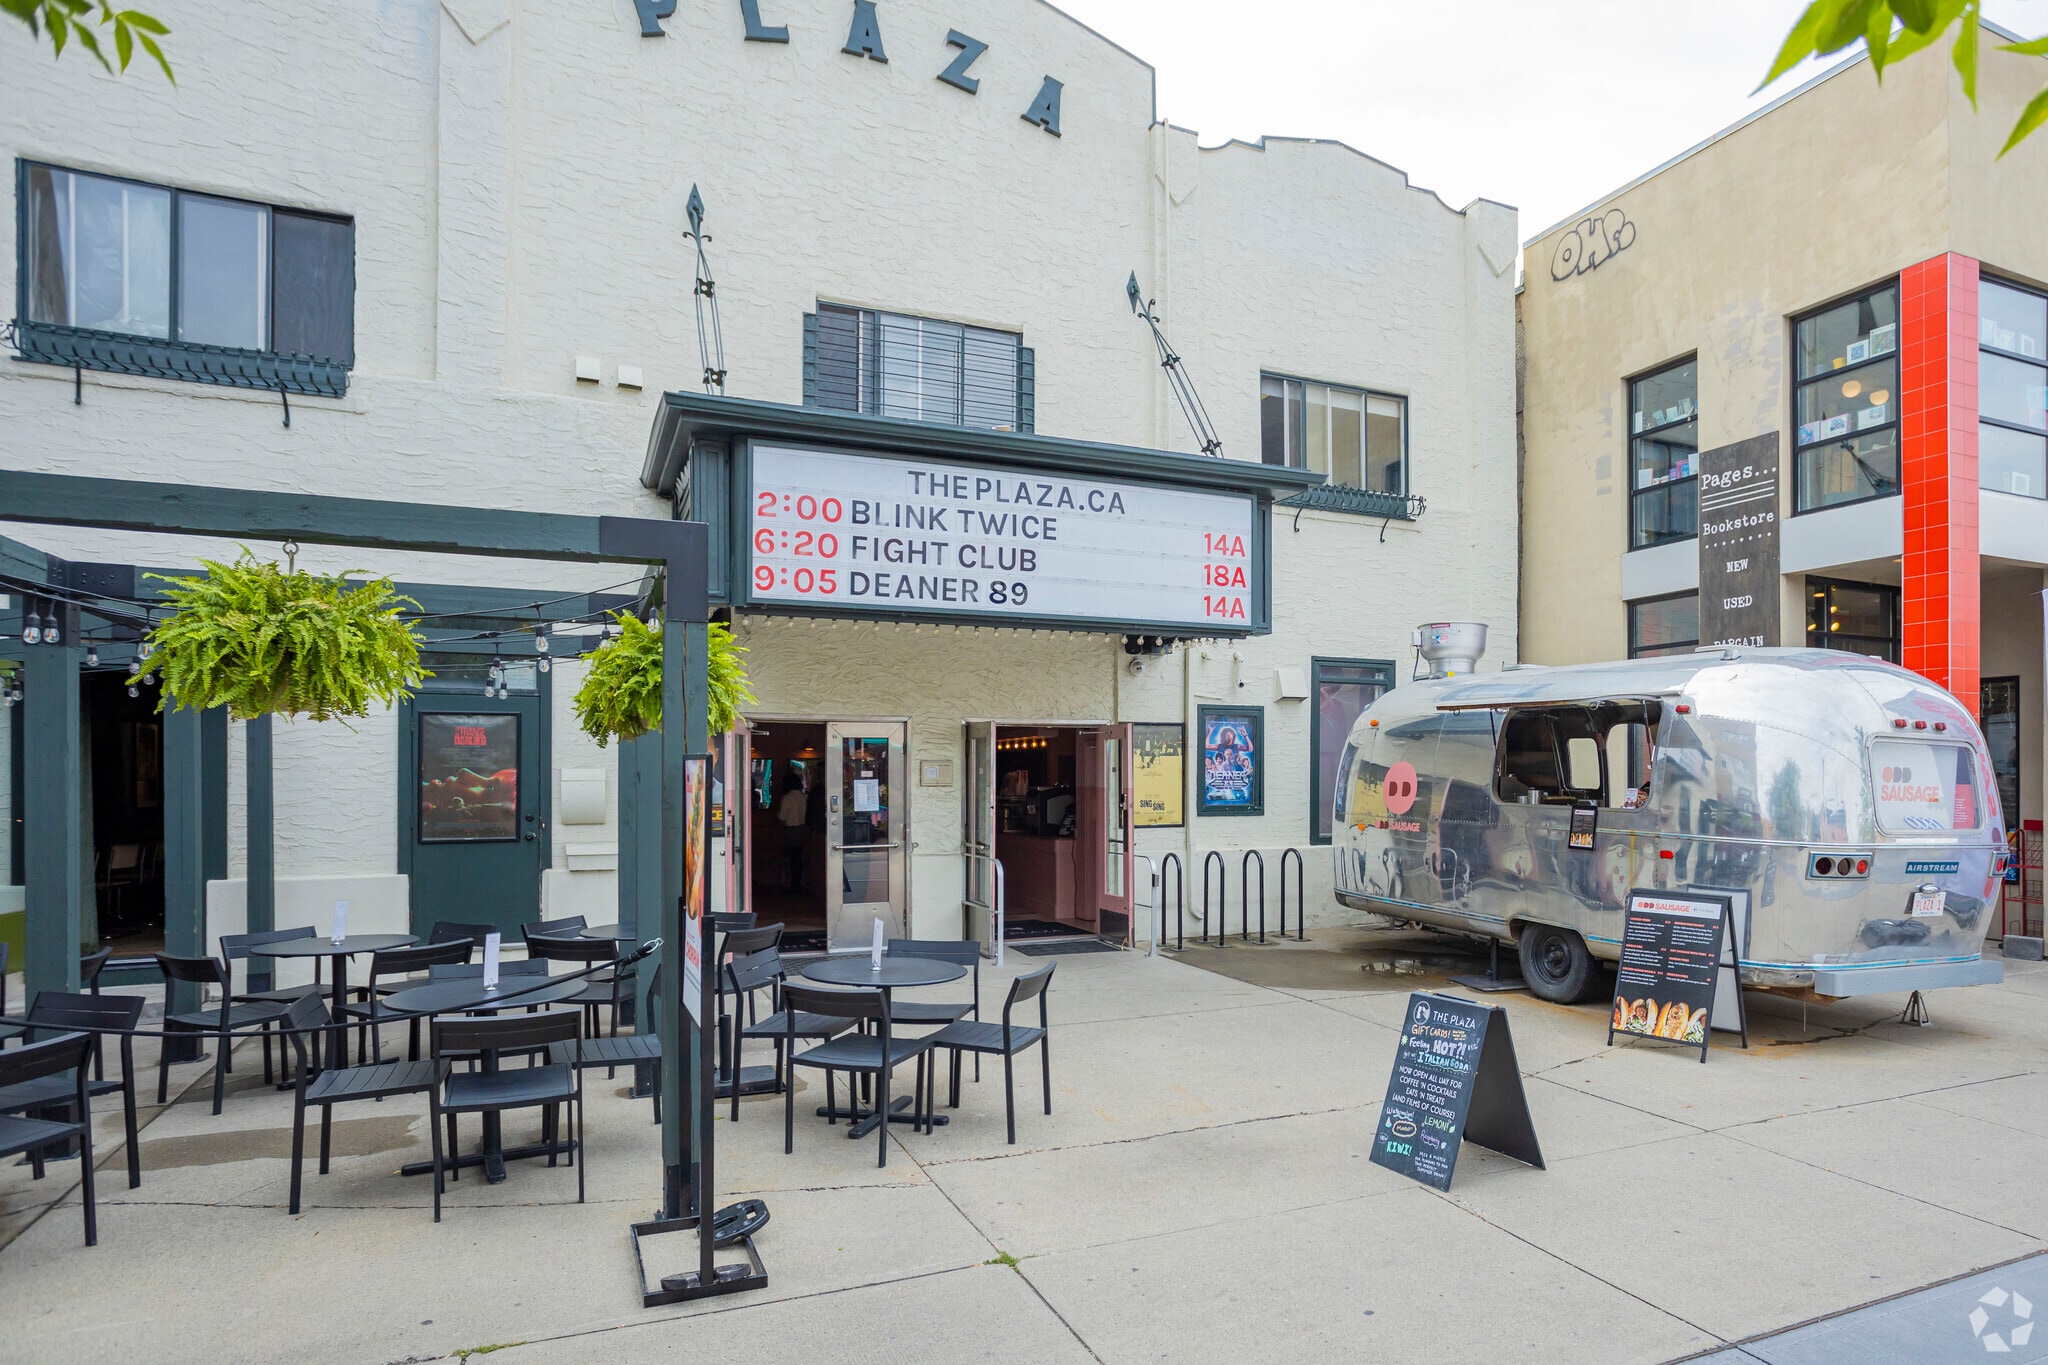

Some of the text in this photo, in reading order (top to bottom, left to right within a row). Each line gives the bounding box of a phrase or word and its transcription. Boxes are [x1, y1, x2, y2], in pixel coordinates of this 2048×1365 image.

[634, 0, 1064, 138] PLAZA
[1701, 465, 1777, 490] Pages...
[757, 491, 1058, 541] 2:00 BLINK TWICE
[1703, 512, 1774, 536] Bookstore
[755, 528, 1037, 572] 6:20 FIGHT CLUB
[1204, 533, 1246, 558] 14A
[1726, 559, 1749, 573] NEW
[1204, 564, 1246, 588] 18A
[755, 567, 1028, 606] 9:05 DEANER 89
[1204, 595, 1245, 619] 14A
[1724, 595, 1753, 609] USED
[1881, 785, 1939, 802] SAUSAGE
[1140, 799, 1165, 811] SING SING
[1390, 821, 1420, 832] SAUSAGE
[1907, 864, 1957, 872] AIRSTREAM
[1655, 903, 1690, 913] SAUSAGE
[1433, 1011, 1475, 1029] THE PLAZA
[1411, 1024, 1430, 1035] GIFT
[1409, 1037, 1430, 1053] Feeling
[1417, 1052, 1450, 1066] ITALIAN
[1450, 1059, 1469, 1070] SODA
[1399, 1065, 1462, 1089] NOW OPEN ALL DAY FOR
[1400, 1075, 1420, 1087] COFFEE
[1427, 1083, 1457, 1098] COCKTAILS
[1406, 1087, 1418, 1097] EATS
[1426, 1093, 1445, 1105] TREATS
[1406, 1098, 1420, 1108] FILMS
[1424, 1115, 1450, 1131] LEMON!
[1386, 1141, 1412, 1156] KIWI!
